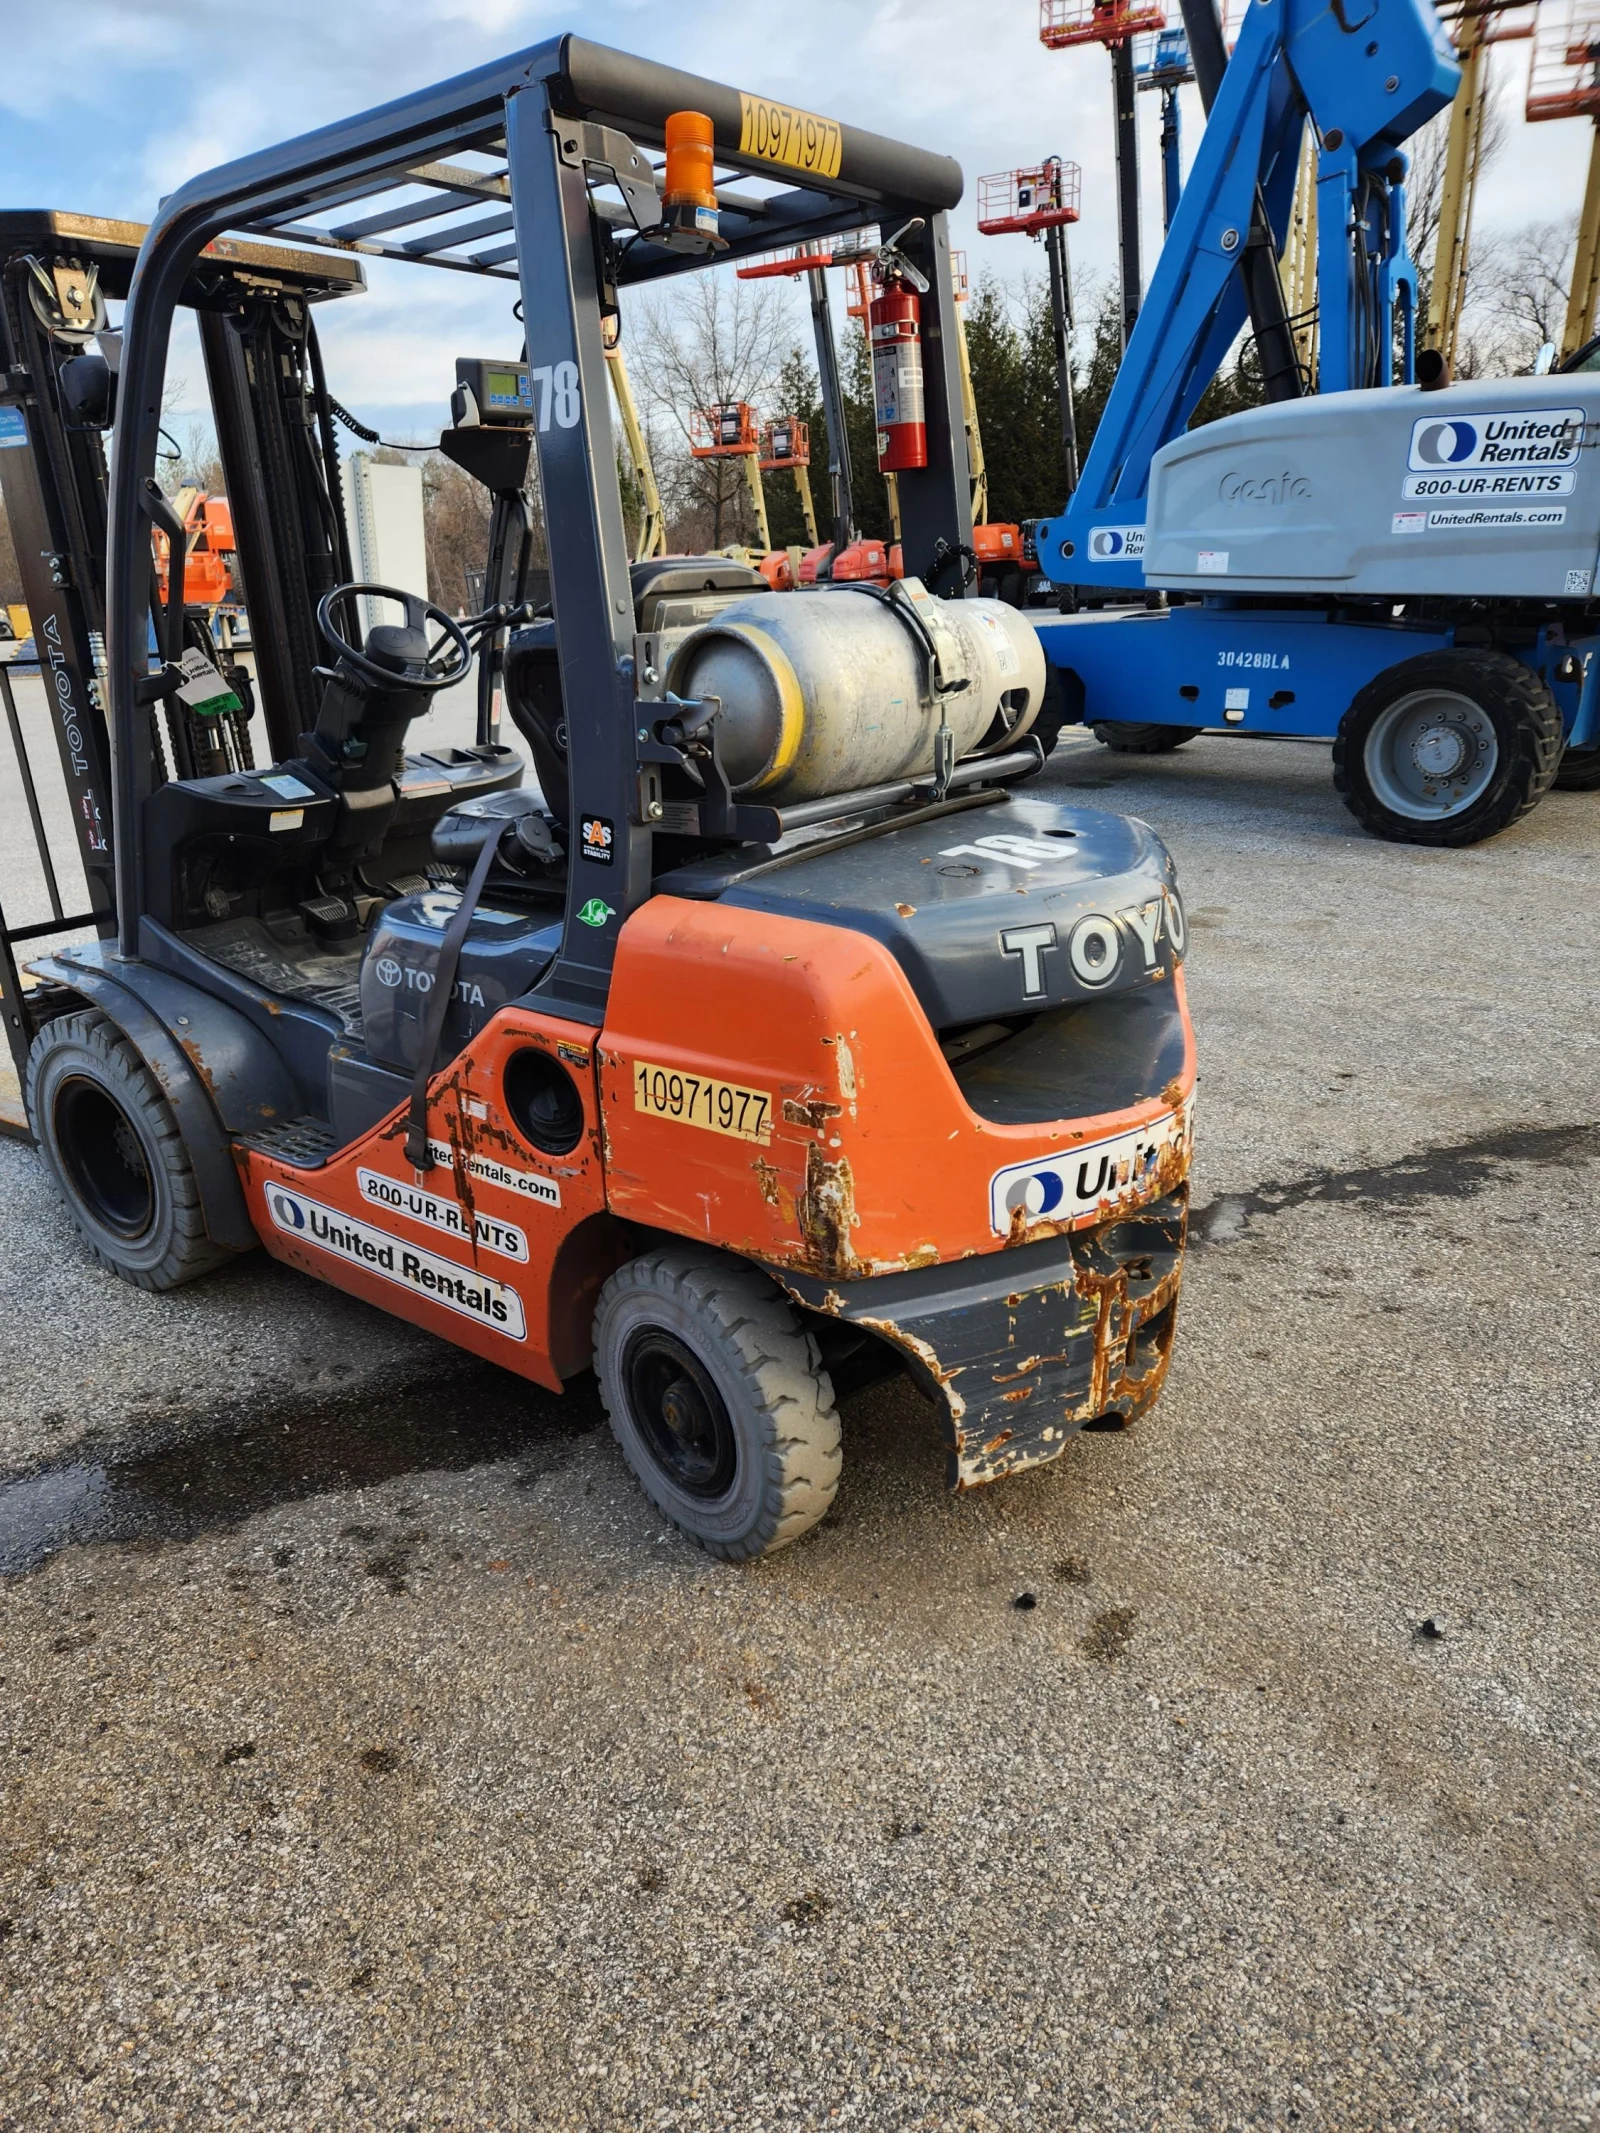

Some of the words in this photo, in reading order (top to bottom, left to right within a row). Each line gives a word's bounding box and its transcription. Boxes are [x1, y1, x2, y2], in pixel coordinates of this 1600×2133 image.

[746, 99, 839, 173] 10971977
[533, 360, 581, 432] 78
[1485, 418, 1571, 441] United
[1480, 441, 1573, 463] Rentals
[1414, 475, 1562, 495] 800-UR-RENTS
[1431, 511, 1563, 526] UnitedRentals.com
[1126, 531, 1146, 543] Uni
[187, 661, 209, 676] United
[1217, 651, 1290, 670] 30428BLA
[191, 667, 216, 680] Rentals
[42, 613, 89, 777] TOYOTA
[582, 820, 612, 847] SAS
[583, 848, 611, 860] STABILITY
[404, 967, 485, 1008] TOTA
[638, 1067, 769, 1137] 10971977
[428, 1142, 558, 1201] itedentals.com
[367, 1178, 519, 1253] 800-UR-RENTS
[310, 1209, 394, 1272] United
[402, 1250, 508, 1323] Rentals
